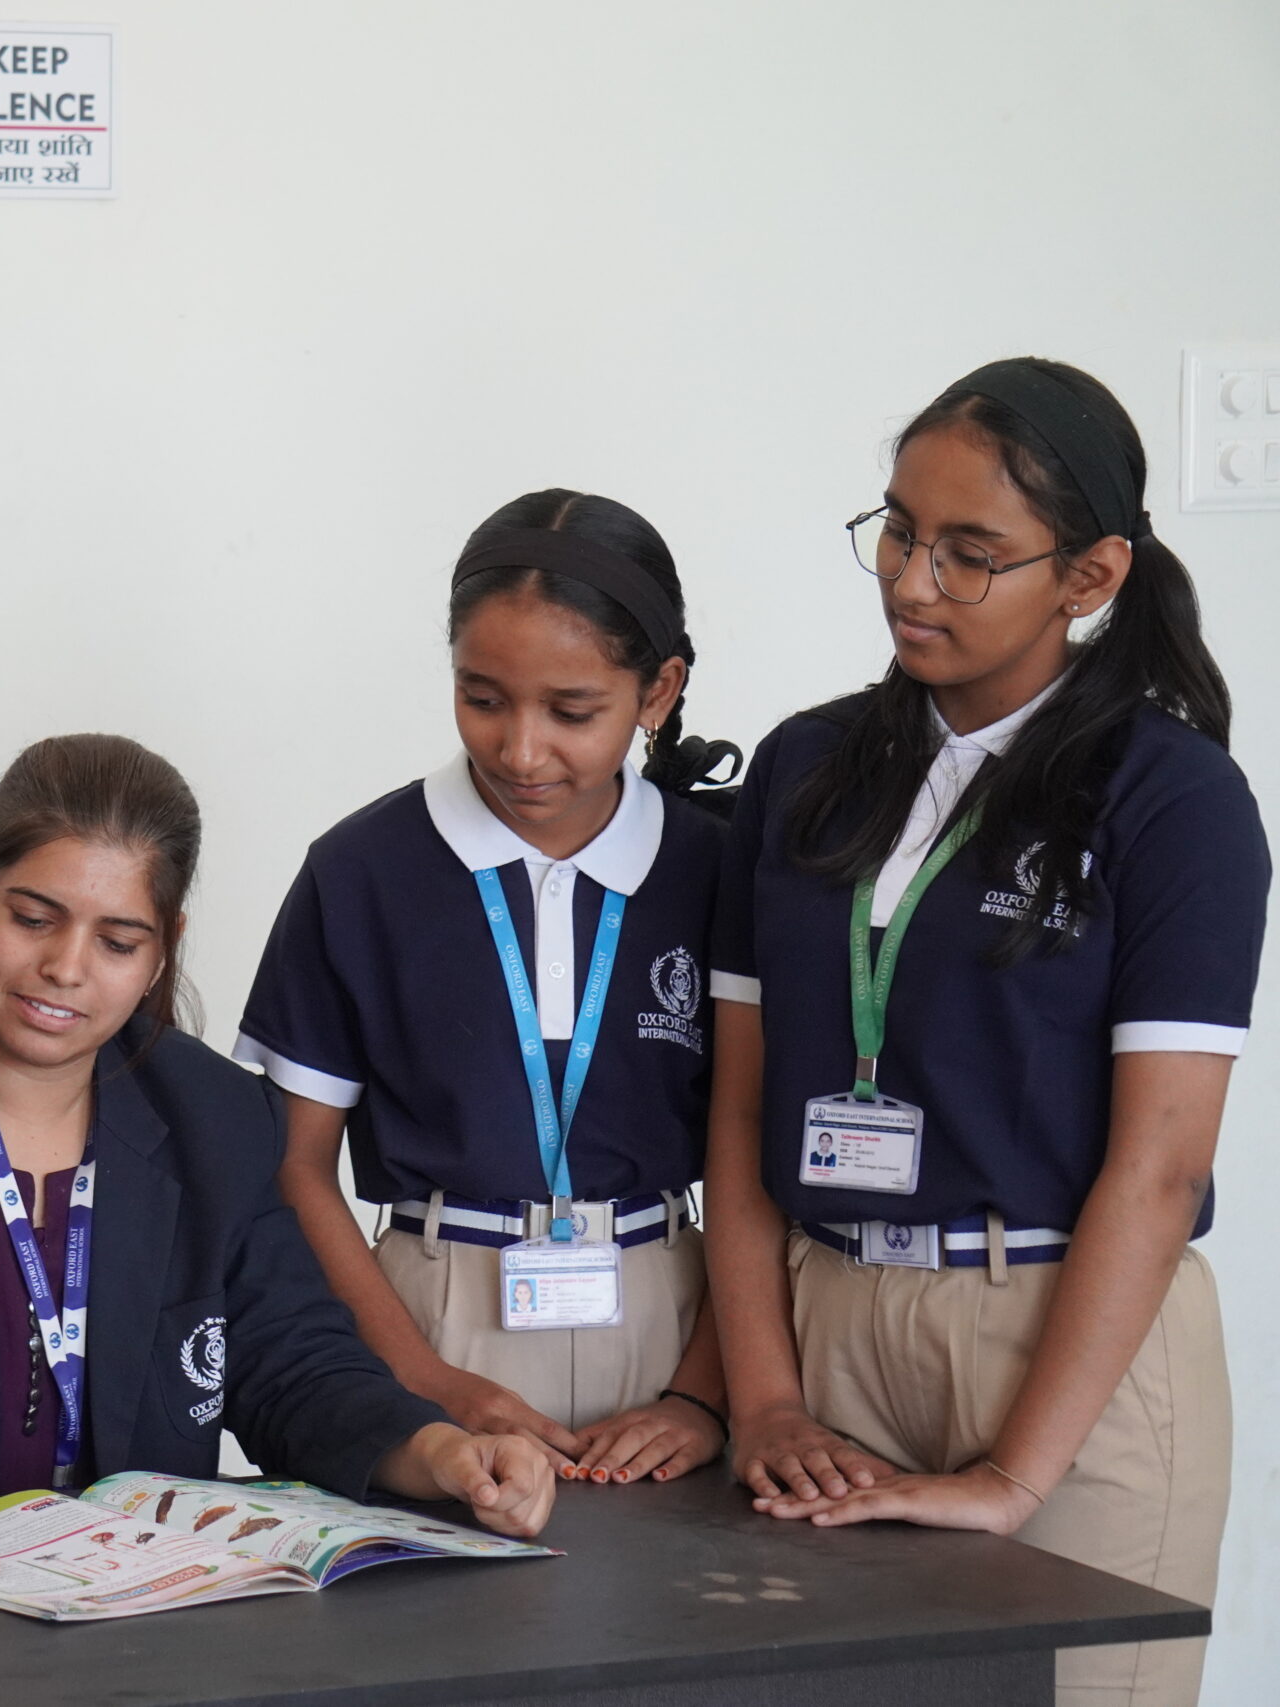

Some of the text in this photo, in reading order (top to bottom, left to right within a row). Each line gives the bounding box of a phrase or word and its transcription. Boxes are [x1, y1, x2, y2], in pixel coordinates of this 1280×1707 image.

[38, 134, 93, 156] शांति
[42, 161, 80, 183] रखें
[985, 890, 1034, 909] OXFO
[505, 944, 524, 988] OXFORD
[516, 988, 531, 1013] EAST
[585, 974, 602, 1018] OXFORD
[594, 950, 608, 974] EAST
[637, 1012, 688, 1032] OXFORD
[537, 1079, 553, 1124] OXFORD
[19, 1241, 43, 1299] OXFORD EAST
[67, 1228, 78, 1287] OXFORD EAST
